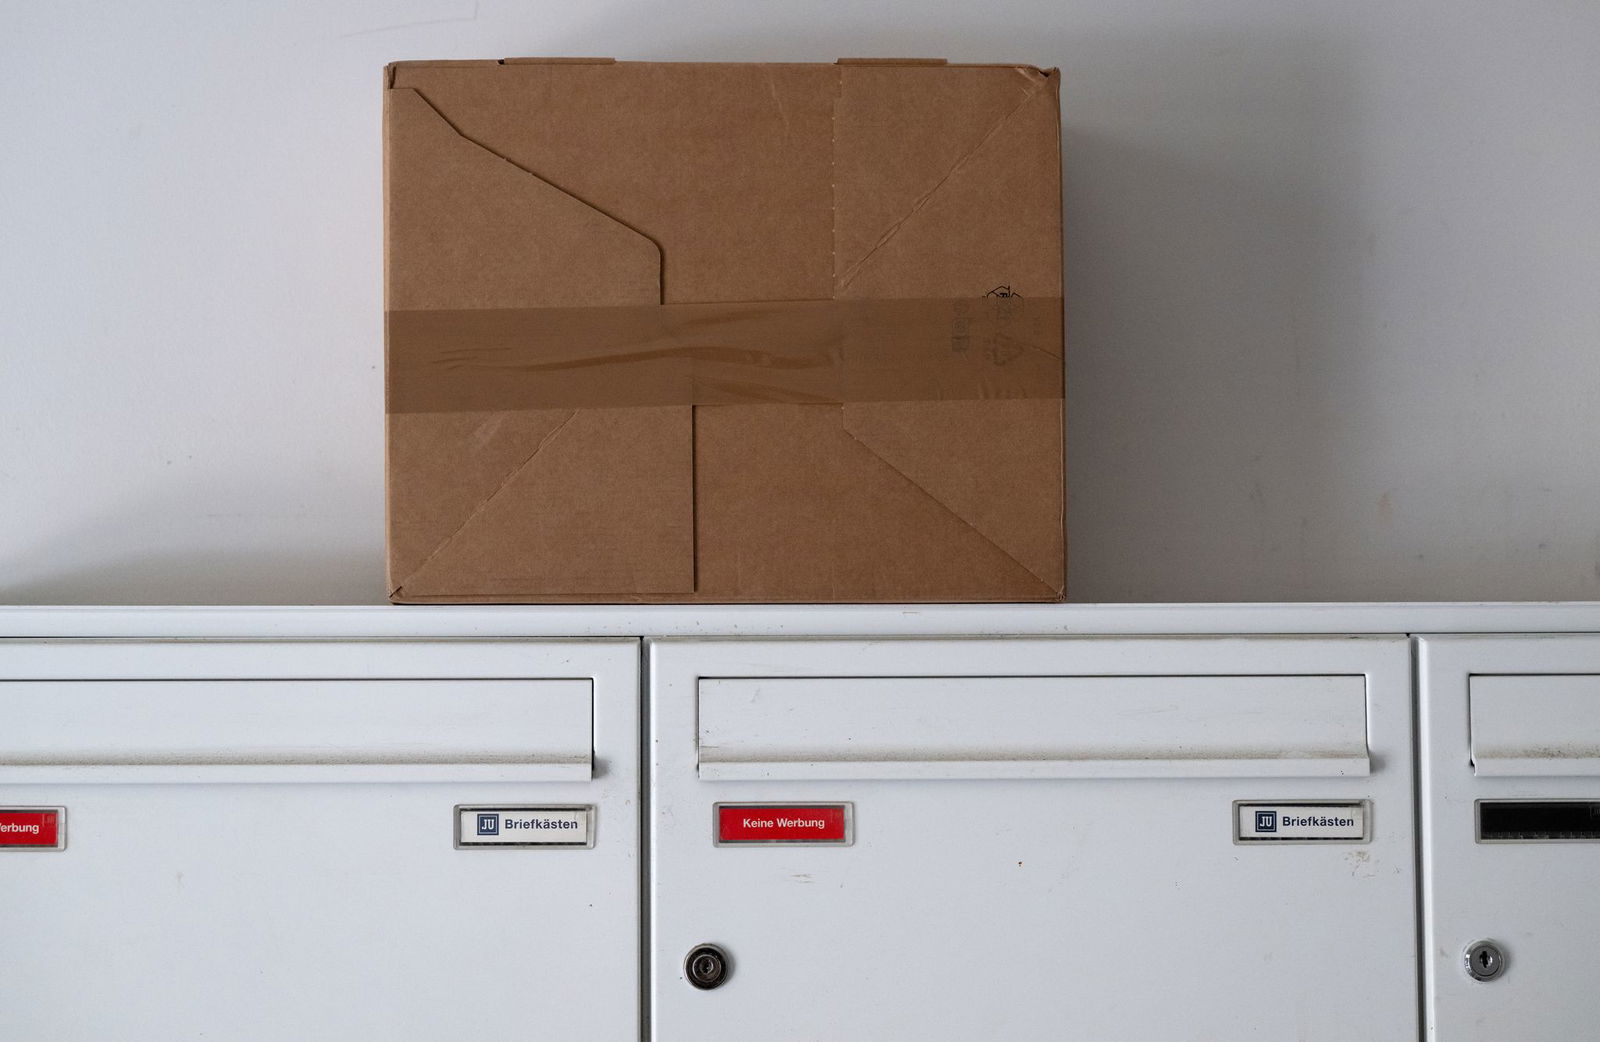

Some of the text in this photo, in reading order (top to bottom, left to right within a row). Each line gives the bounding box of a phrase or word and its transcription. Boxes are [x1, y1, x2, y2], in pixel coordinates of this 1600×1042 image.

[481, 819, 578, 830] JU Briefkästen
[743, 818, 825, 830] Keine Werbung
[1259, 816, 1354, 828] JU Briefkästen
[0, 822, 40, 835] erbung
